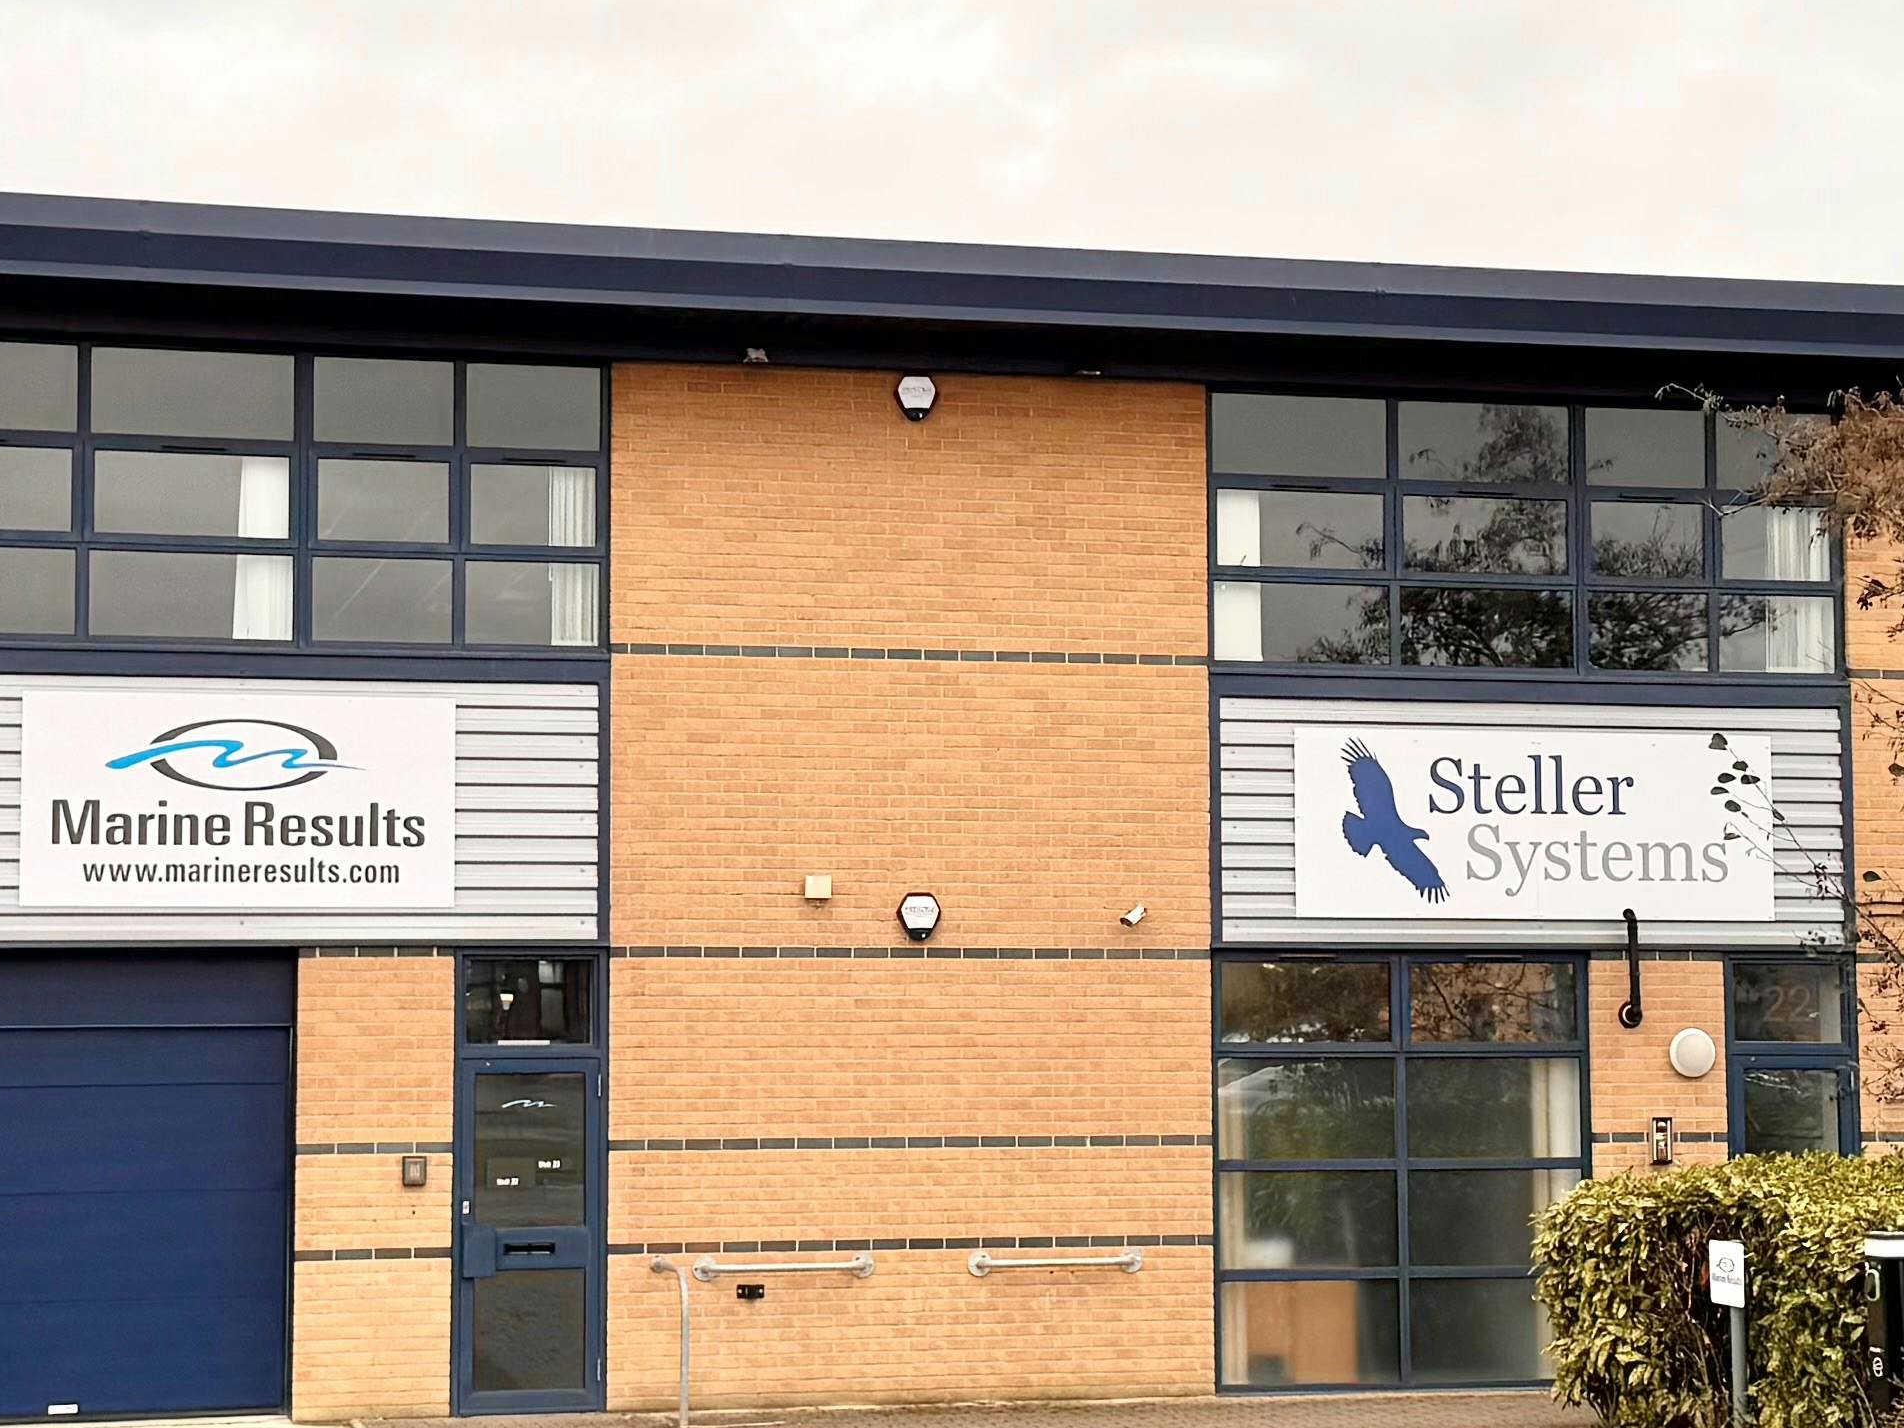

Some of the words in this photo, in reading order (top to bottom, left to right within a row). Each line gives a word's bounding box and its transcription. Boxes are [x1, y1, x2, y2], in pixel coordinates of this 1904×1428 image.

[1428, 754, 1635, 816] Steller
[51, 798, 231, 847] Marine
[244, 800, 426, 848] Results
[82, 856, 400, 884] www.marineresults.com
[1466, 822, 1729, 897] Systems
